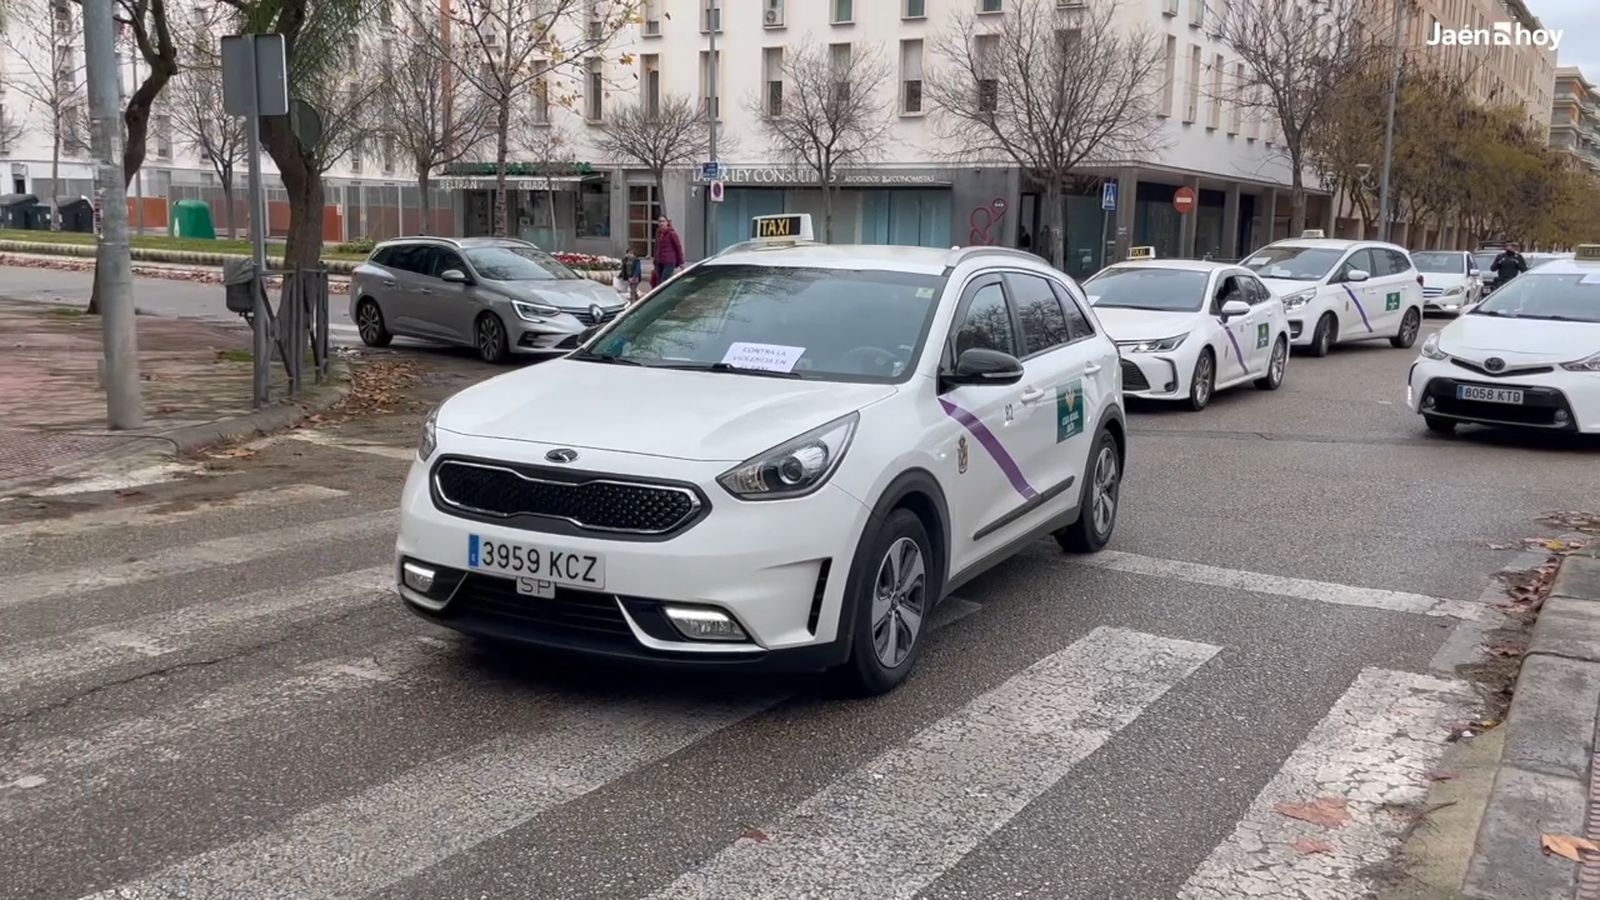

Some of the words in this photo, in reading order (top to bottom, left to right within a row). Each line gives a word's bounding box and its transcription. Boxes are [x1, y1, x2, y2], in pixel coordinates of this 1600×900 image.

[732, 169, 751, 182] LEY
[760, 218, 790, 236] TAXI
[742, 346, 775, 356] CONTRA
[1464, 387, 1494, 400] 8058
[482, 541, 540, 574] 3959
[549, 551, 598, 583] KCZ
[520, 576, 551, 595] SP
